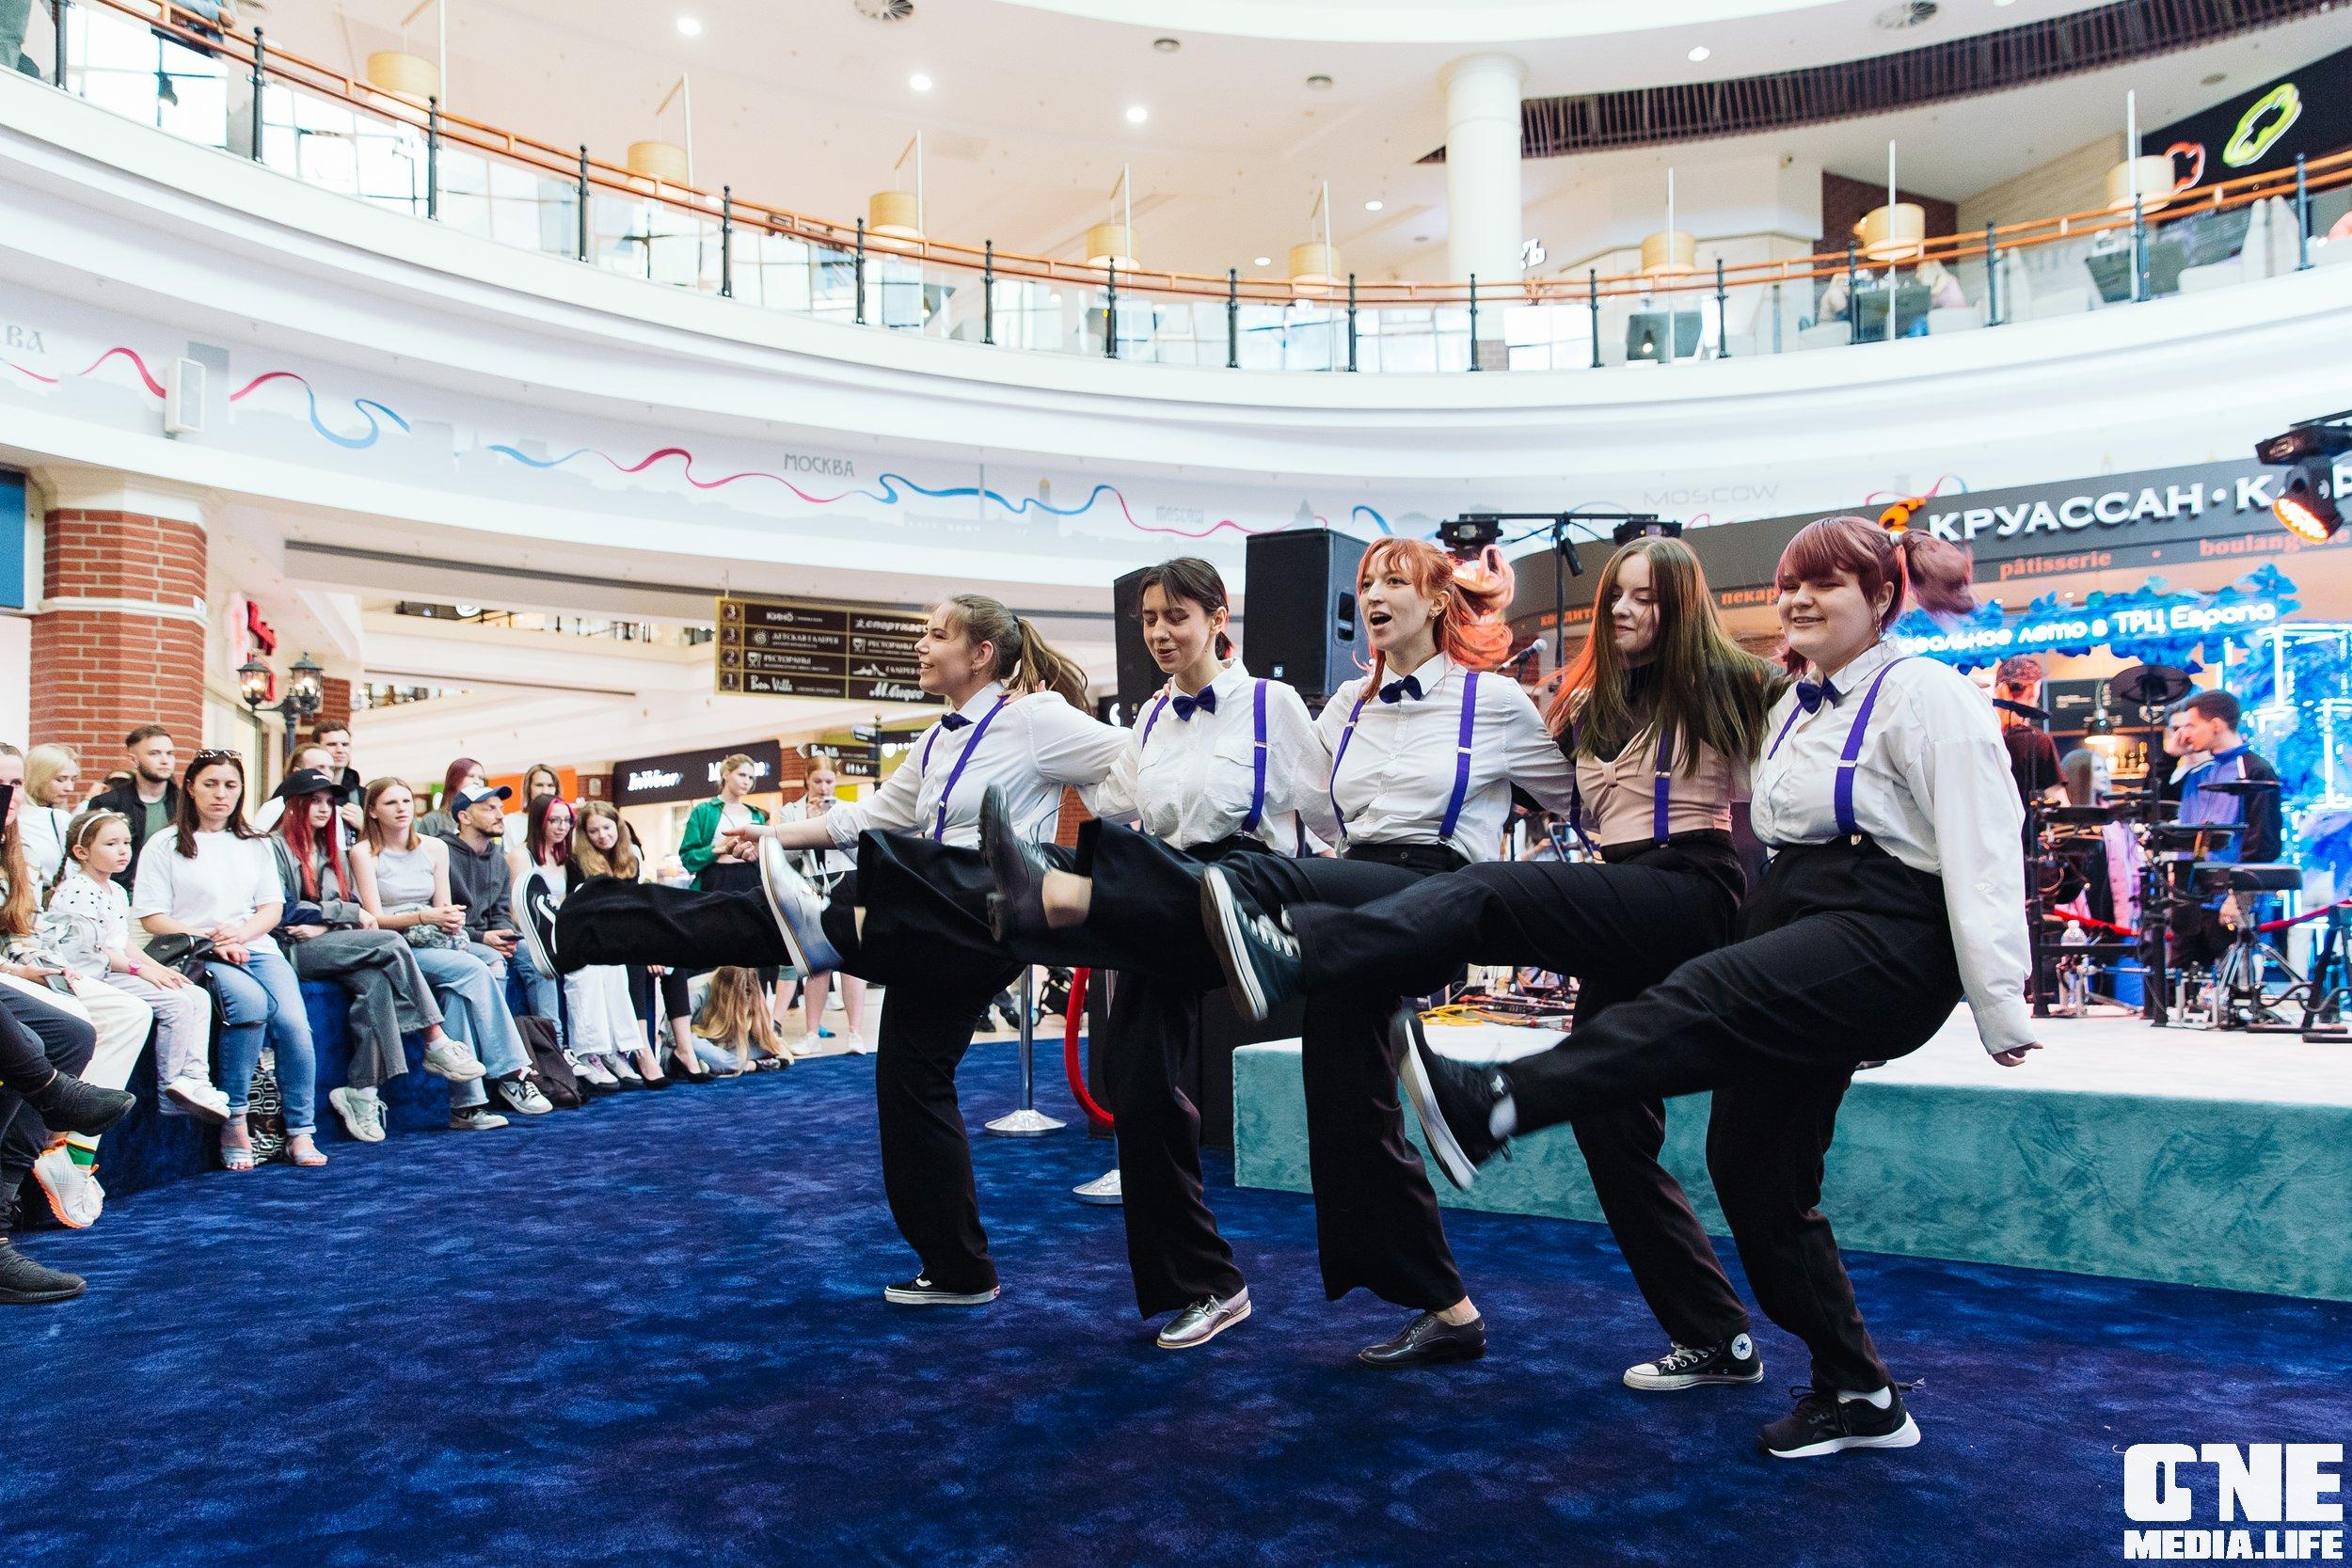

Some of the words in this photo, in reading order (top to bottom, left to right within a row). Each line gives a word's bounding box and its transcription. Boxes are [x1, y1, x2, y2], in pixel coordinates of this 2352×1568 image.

[784, 452, 854, 477] МОСКВА
[1644, 484, 1778, 507] MOSCOW
[1929, 483, 2204, 541] КРУАССАН
[1998, 551, 2111, 580] pâtisserie
[726, 604, 736, 619] 3
[2018, 621, 2088, 643] лето
[2091, 618, 2108, 637] в
[2112, 609, 2166, 634] ТРЦ
[2170, 602, 2276, 631] Европа
